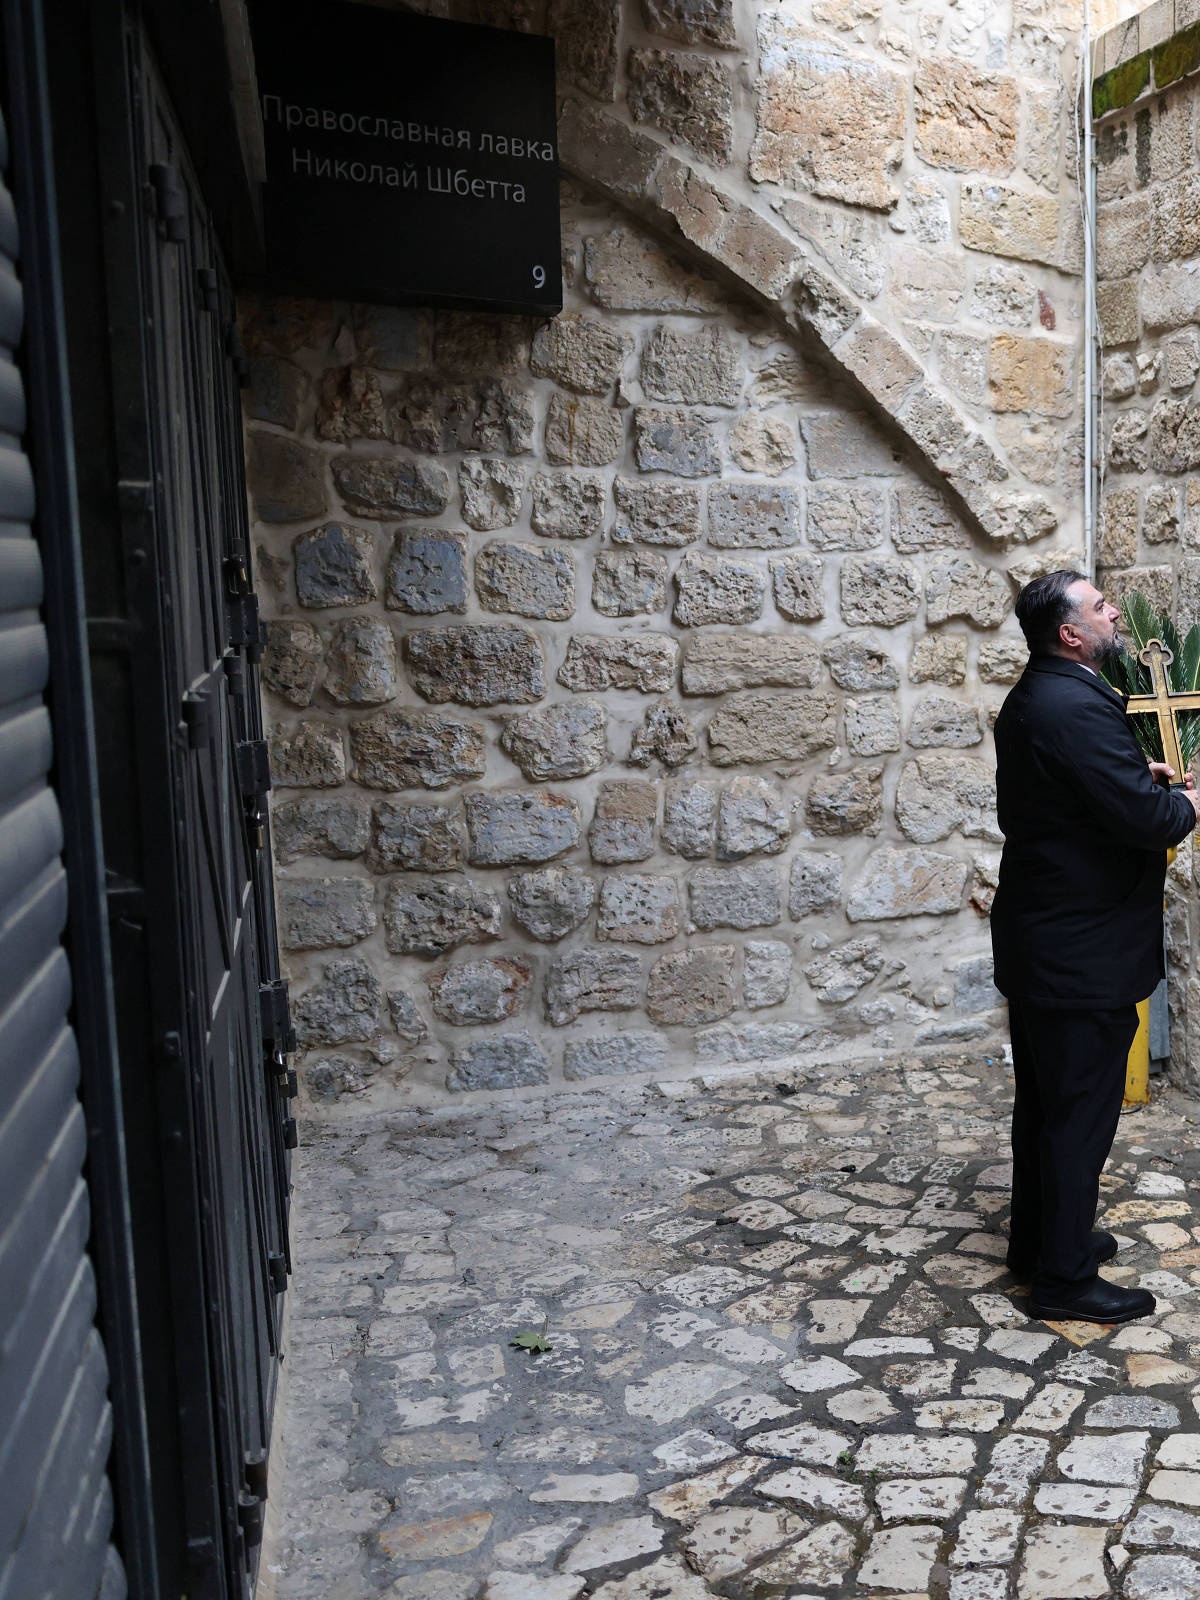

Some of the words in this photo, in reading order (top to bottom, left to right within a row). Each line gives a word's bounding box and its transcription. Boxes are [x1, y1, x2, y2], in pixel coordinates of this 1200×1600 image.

[262, 94, 470, 150] Православная
[478, 133, 554, 161] лавка
[291, 147, 418, 189] Николай
[427, 165, 526, 203] Шбетта
[532, 265, 546, 289] 9
